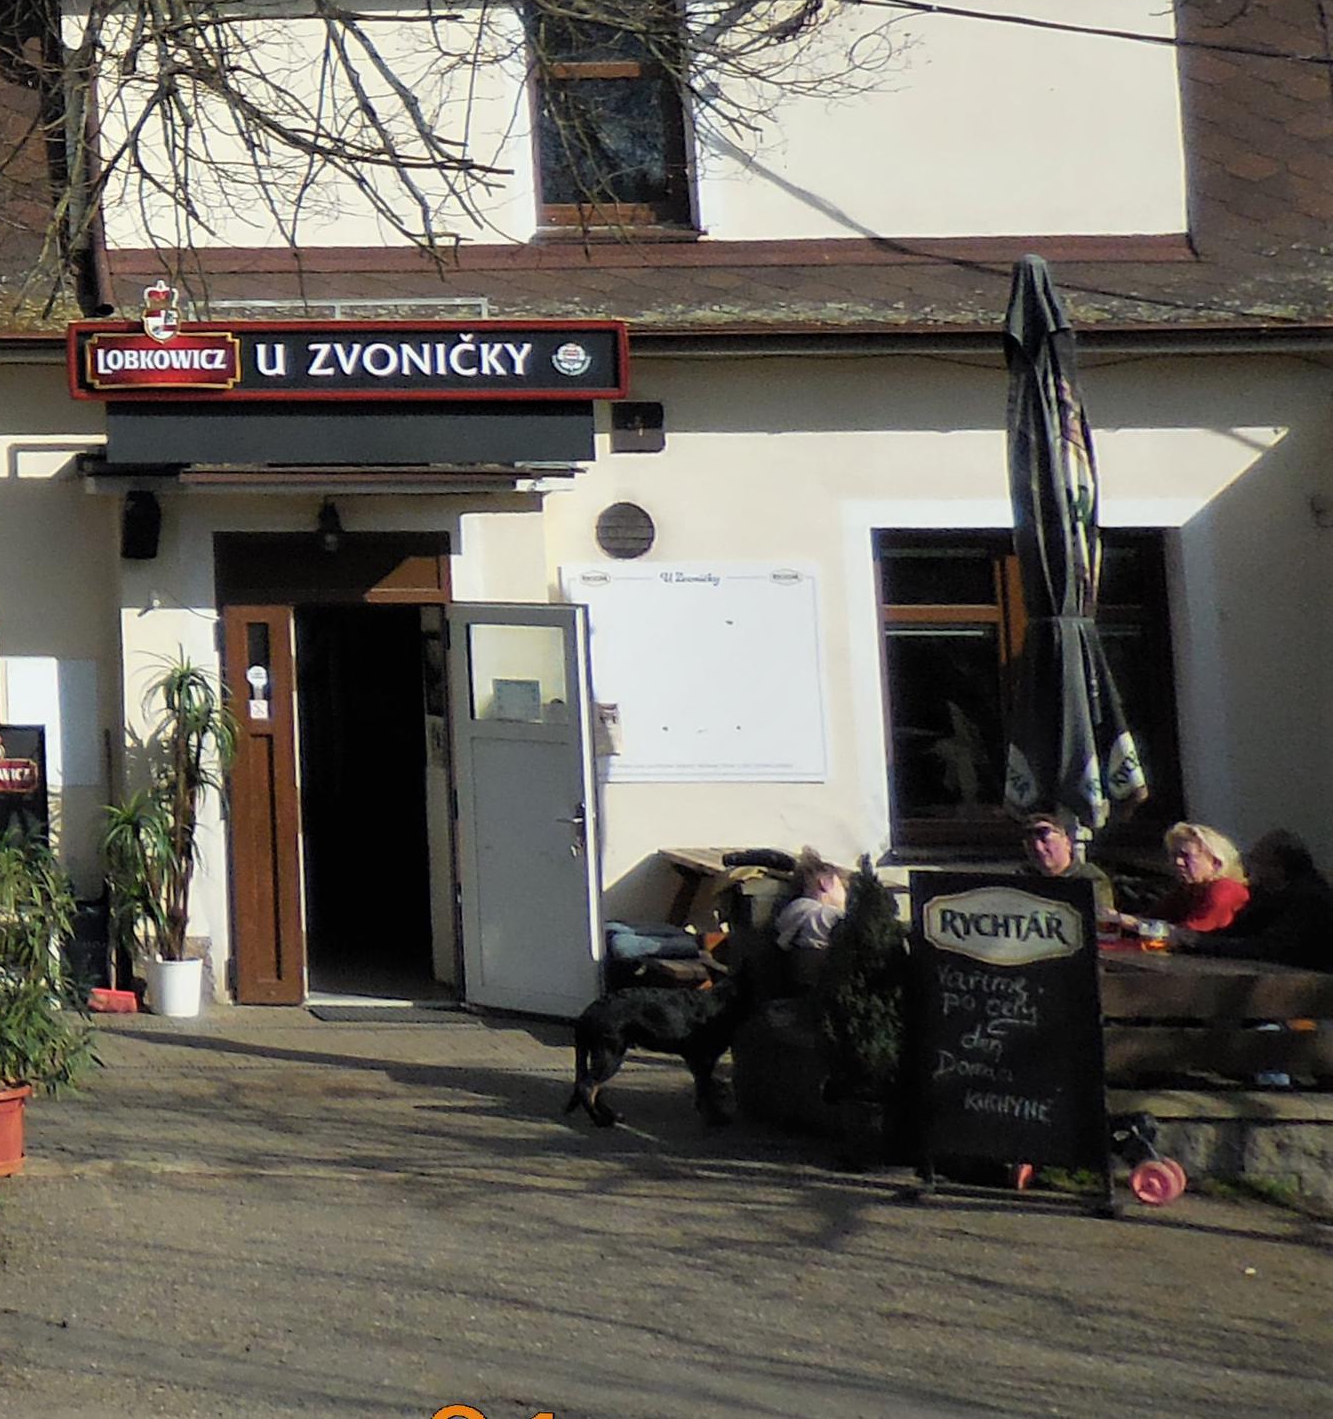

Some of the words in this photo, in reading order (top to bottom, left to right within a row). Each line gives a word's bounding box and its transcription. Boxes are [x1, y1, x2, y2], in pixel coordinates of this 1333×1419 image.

[97, 348, 227, 374] LOBKOWICZ
[256, 343, 286, 376] U
[307, 333, 532, 377] ZVONIČKY
[939, 909, 1069, 945] RYCHTÁŘ
